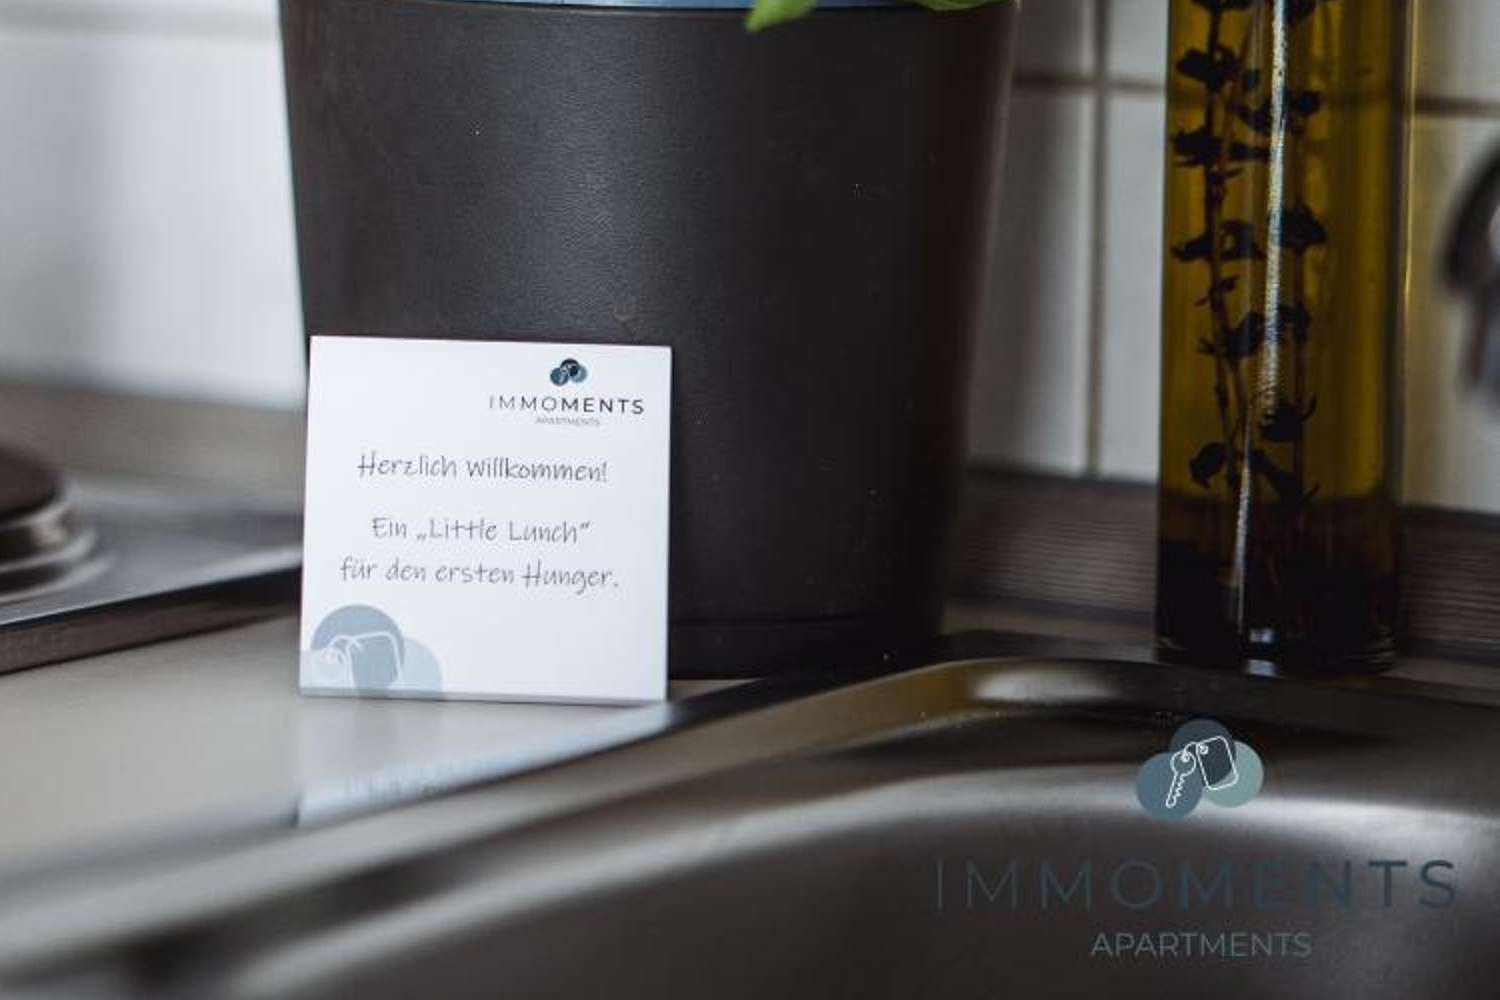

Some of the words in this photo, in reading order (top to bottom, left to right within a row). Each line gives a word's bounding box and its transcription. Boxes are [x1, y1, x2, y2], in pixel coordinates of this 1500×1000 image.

[488, 394, 645, 416] IMMOMENTS
[356, 450, 457, 479] Herzlich
[466, 456, 610, 483] Willkommen!
[371, 516, 408, 540] Ein
[339, 555, 379, 584] für
[385, 557, 428, 583] den
[434, 562, 516, 585] ersten
[521, 559, 620, 595] Hunger.
